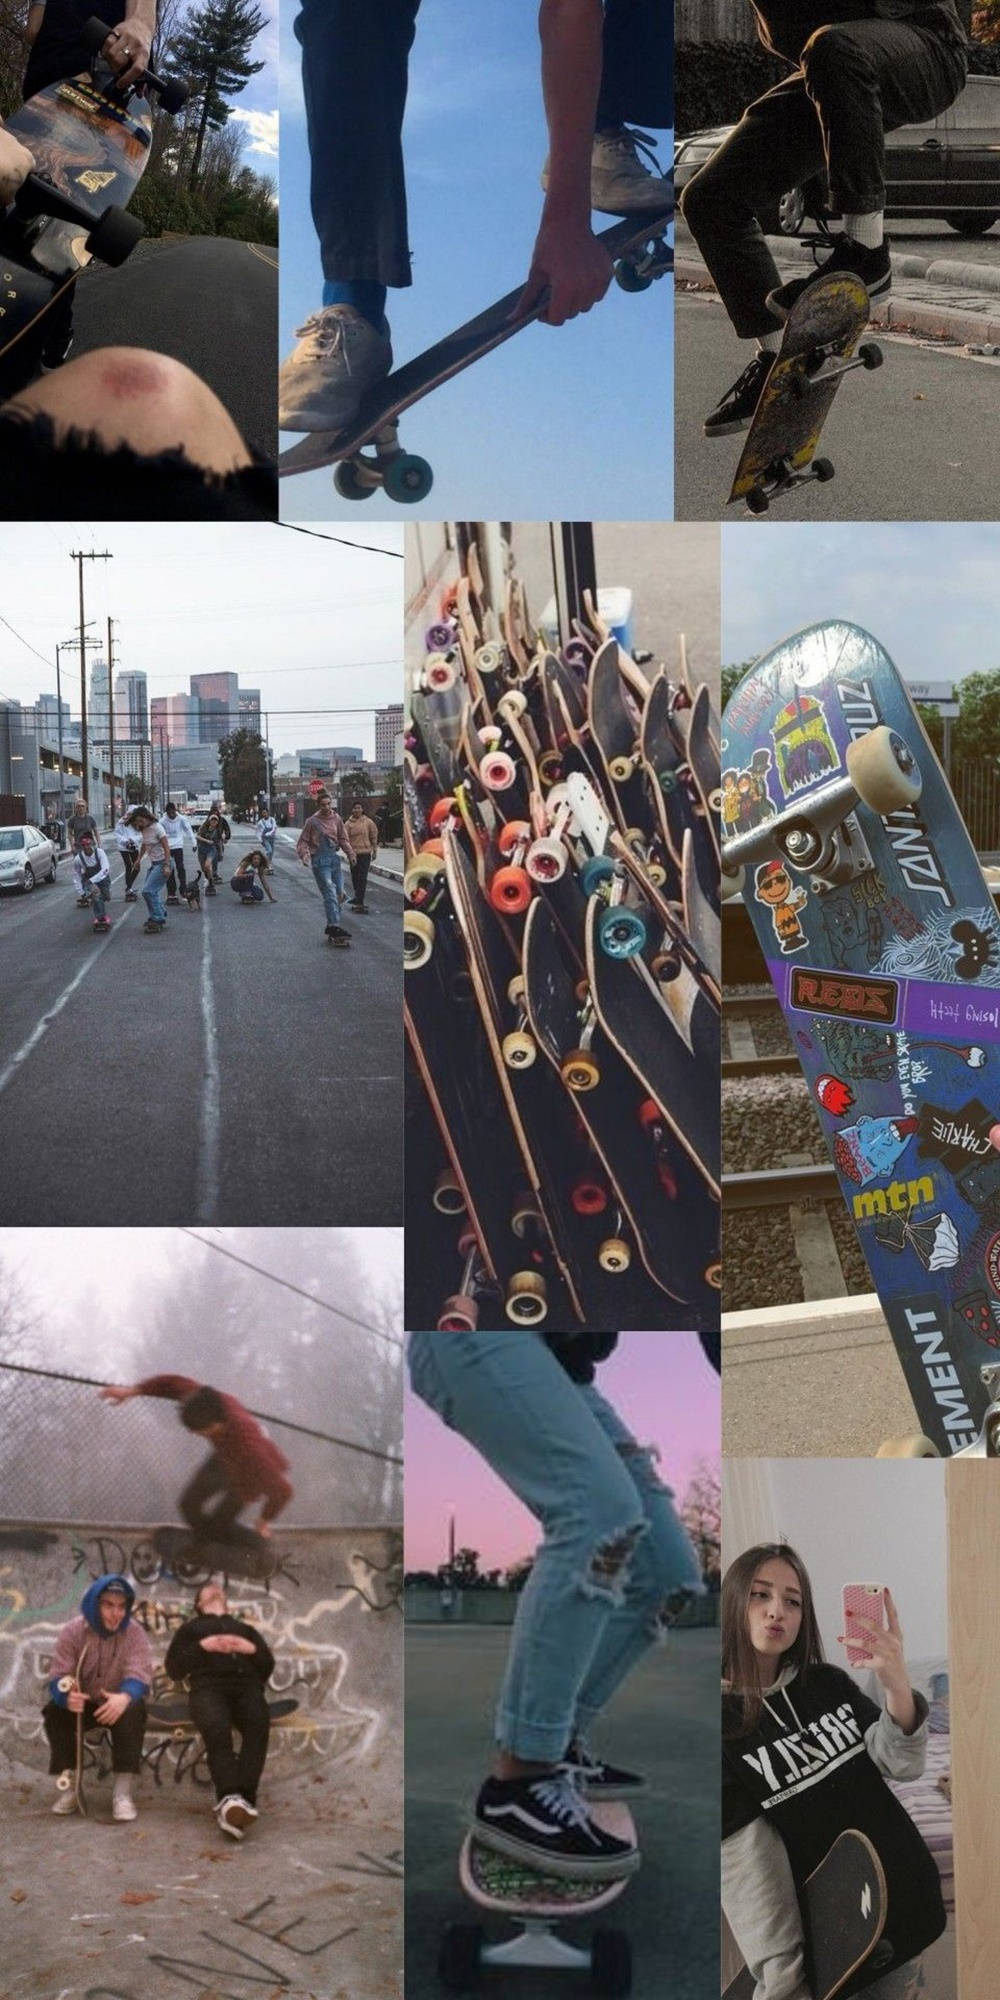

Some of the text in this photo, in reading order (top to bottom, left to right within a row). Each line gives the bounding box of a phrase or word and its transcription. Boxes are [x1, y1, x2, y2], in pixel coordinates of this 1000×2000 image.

[965, 1003, 999, 1028] losing
[897, 1057, 910, 1081] EVEN
[904, 1102, 916, 1116] DO
[931, 1116, 993, 1155] CHARLIE
[852, 1176, 935, 1220] mtn
